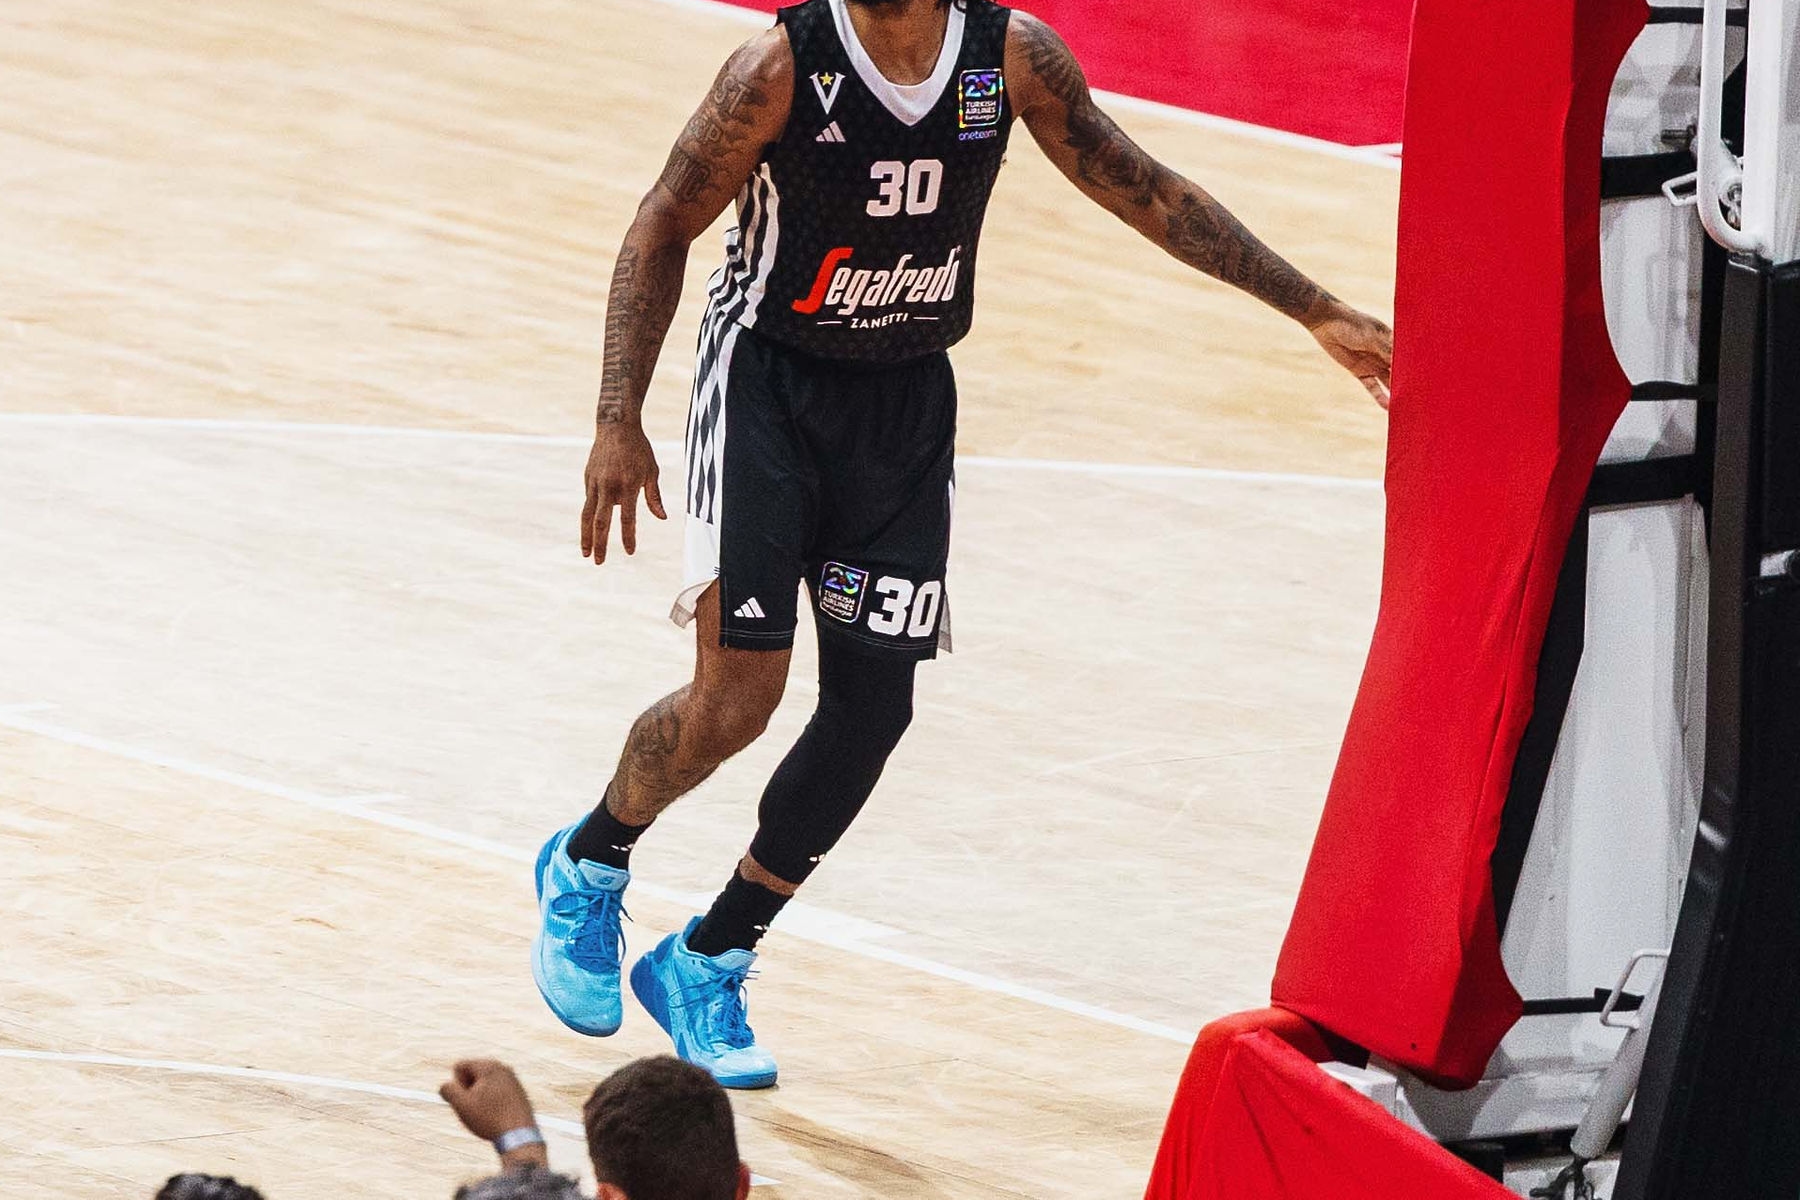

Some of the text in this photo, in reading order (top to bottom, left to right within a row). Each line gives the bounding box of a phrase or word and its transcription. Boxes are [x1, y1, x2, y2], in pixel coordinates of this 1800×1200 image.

[865, 159, 944, 217] 30
[791, 247, 960, 316] Segafredo
[850, 312, 909, 330] ZANETTI
[867, 575, 942, 637] 30
